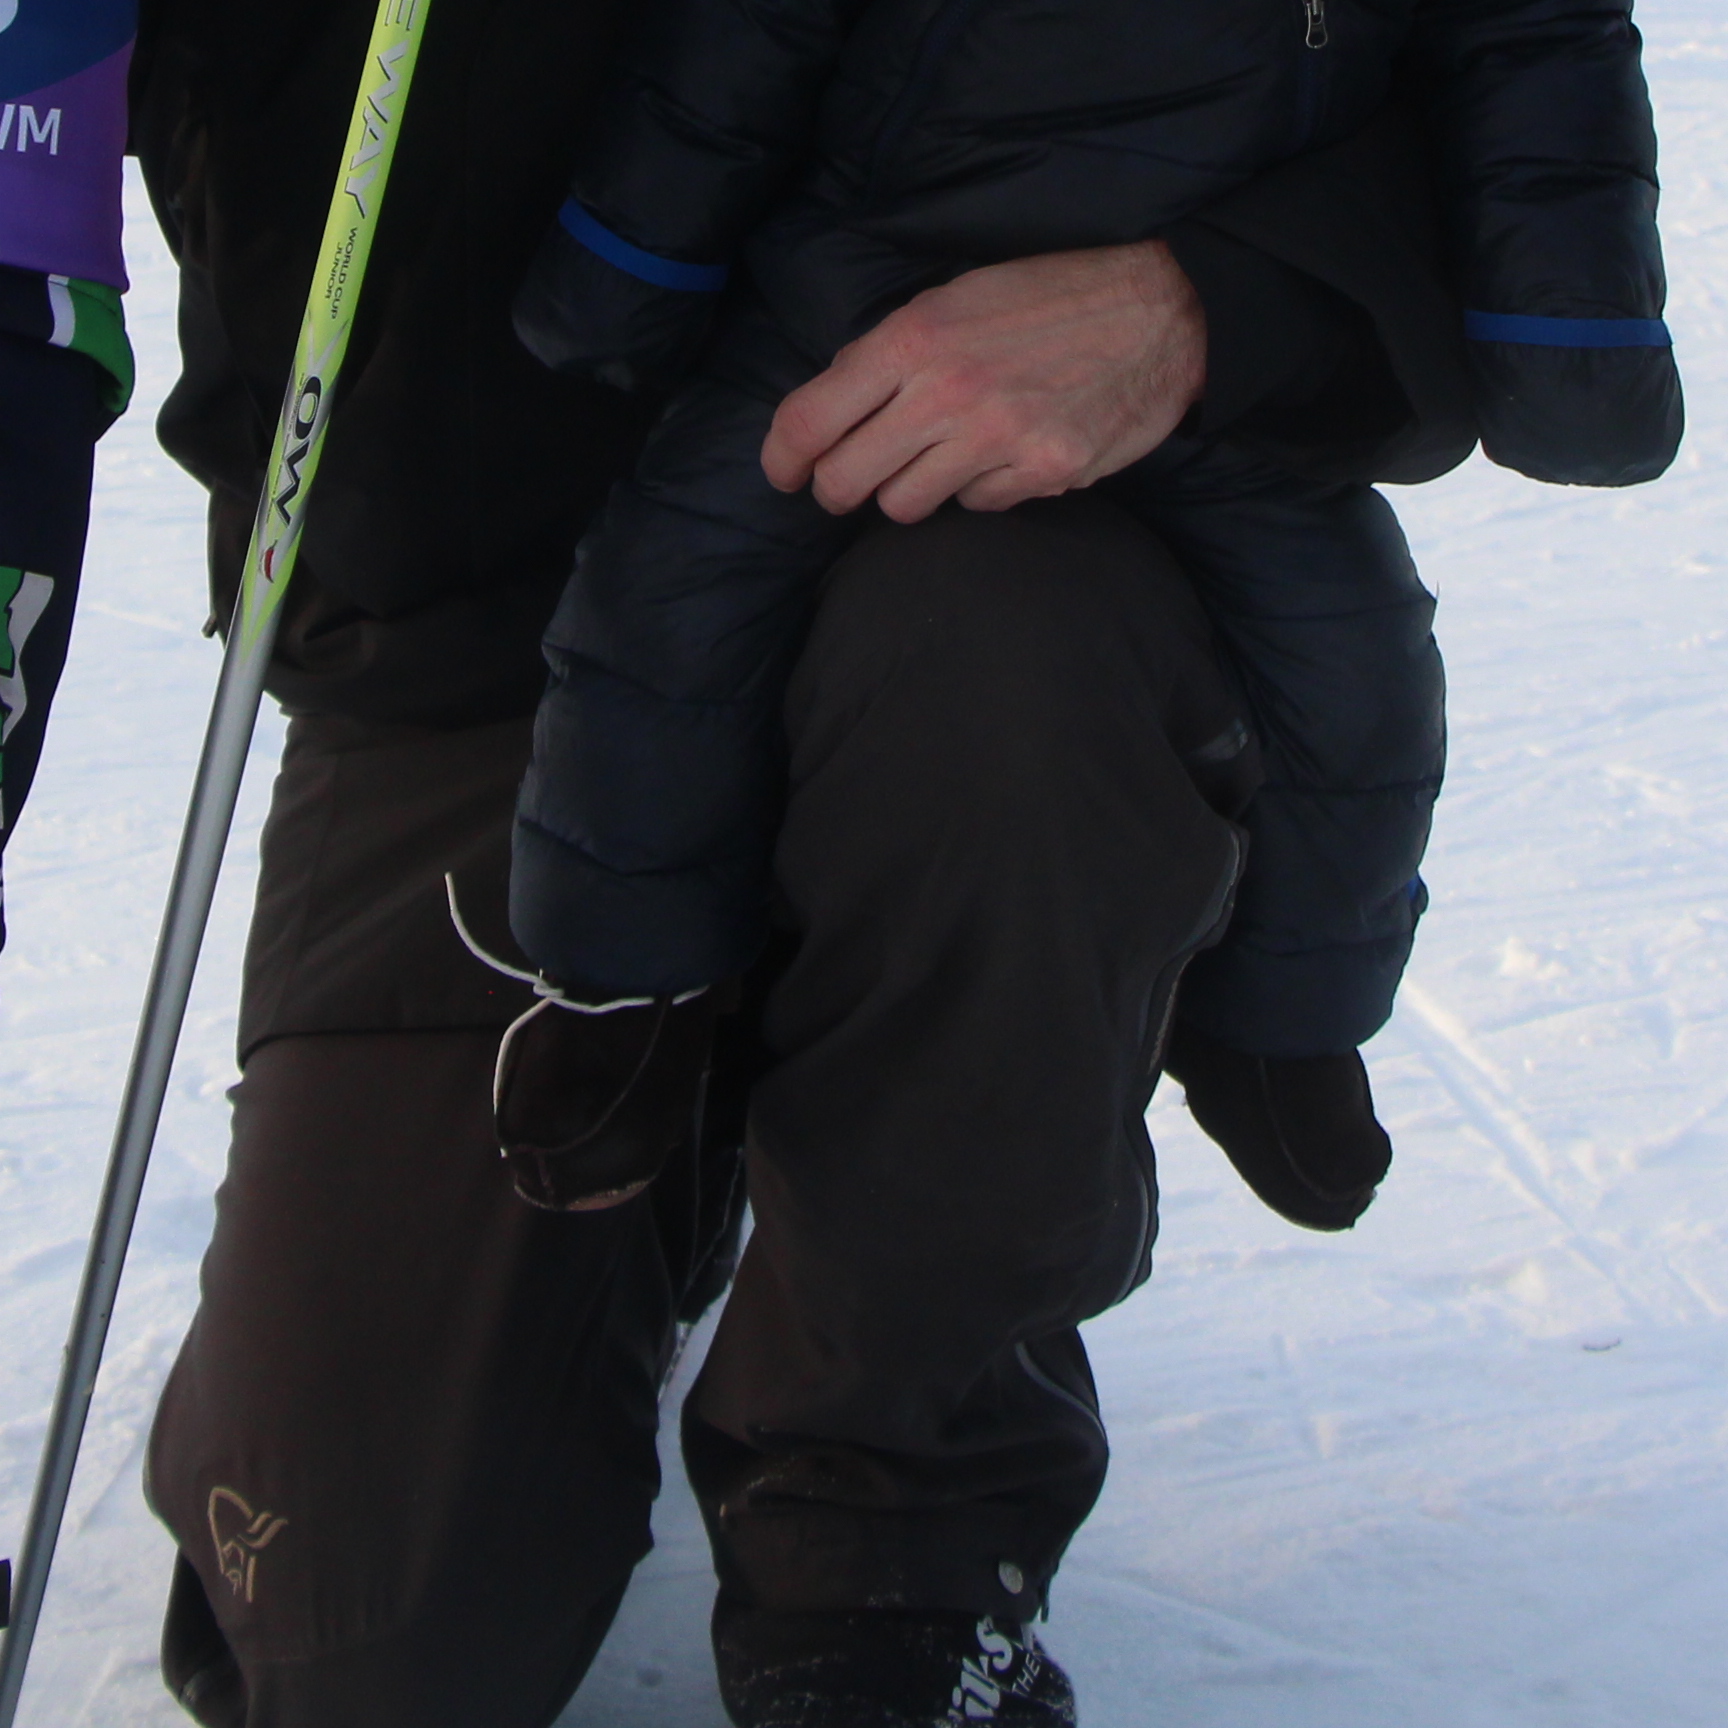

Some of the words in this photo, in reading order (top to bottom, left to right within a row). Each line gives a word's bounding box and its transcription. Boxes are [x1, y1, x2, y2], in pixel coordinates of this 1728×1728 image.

[344, 39, 410, 220] WAY
[324, 241, 343, 299] JUNIOR
[337, 226, 358, 285] WORLD
[330, 286, 343, 320] CUP
[274, 374, 322, 528] OW
